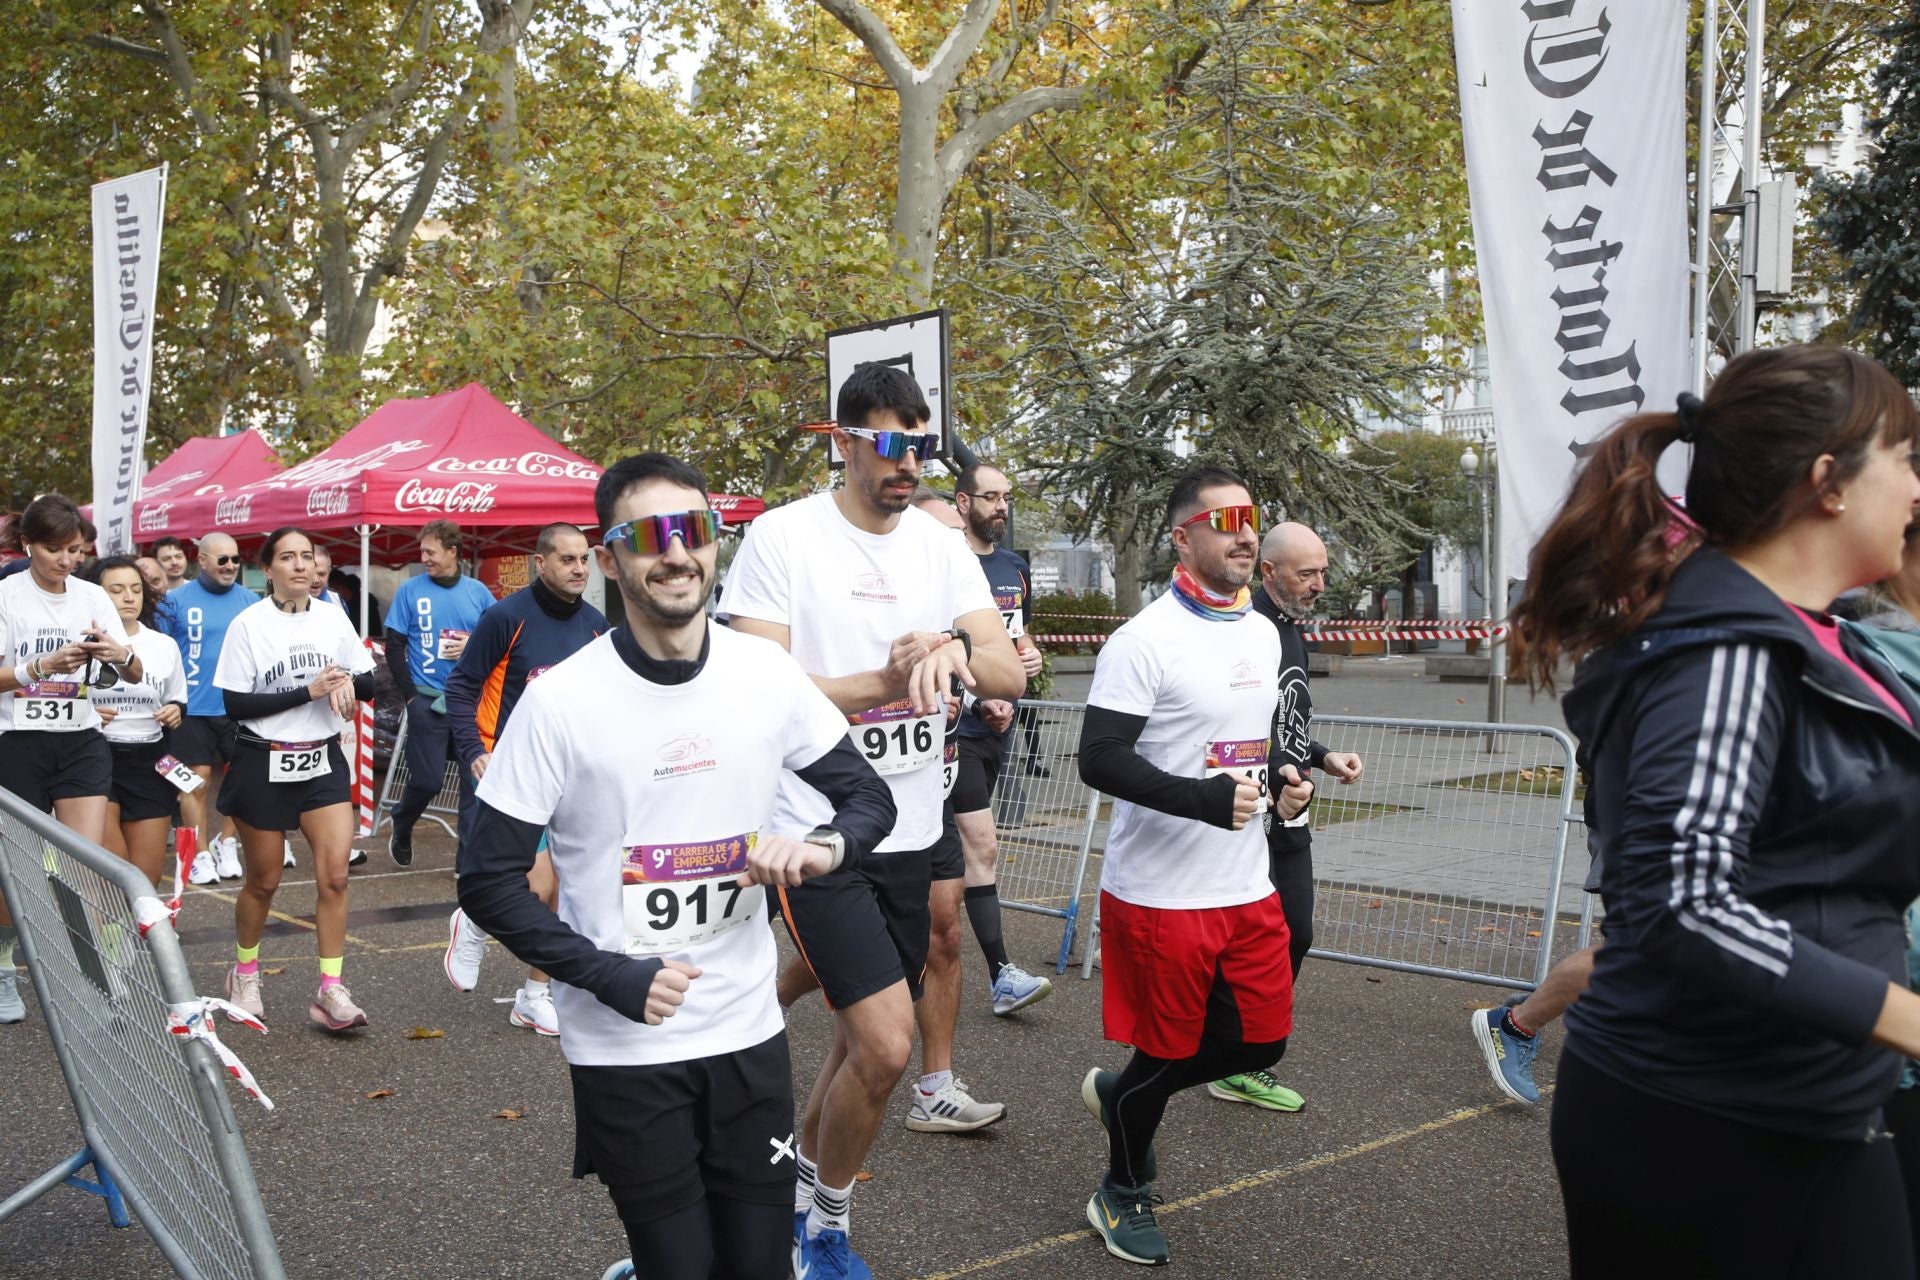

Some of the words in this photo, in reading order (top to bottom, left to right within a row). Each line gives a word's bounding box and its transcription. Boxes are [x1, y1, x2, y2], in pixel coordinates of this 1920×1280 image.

[427, 451, 600, 481] Coca-Cola
[307, 482, 353, 517] Coca-Cola
[394, 478, 498, 514] Coca-Cola
[37, 628, 69, 638] HOSPITAL
[1002, 612, 1015, 630] 7
[187, 607, 203, 686] IVECO
[417, 597, 435, 674] IVECO
[264, 660, 285, 686] RIO
[25, 700, 74, 720] 531
[881, 700, 913, 712] EMPRESA
[862, 720, 932, 760] 916
[280, 750, 322, 773] 529
[653, 759, 717, 777] Automucientes
[652, 848, 672, 869] 9ª
[673, 845, 714, 857] CARRERA
[716, 843, 727, 853] DE
[673, 853, 727, 869] EMPRESAS
[646, 880, 745, 931] 917
[1490, 1027, 1506, 1060] HOKA
